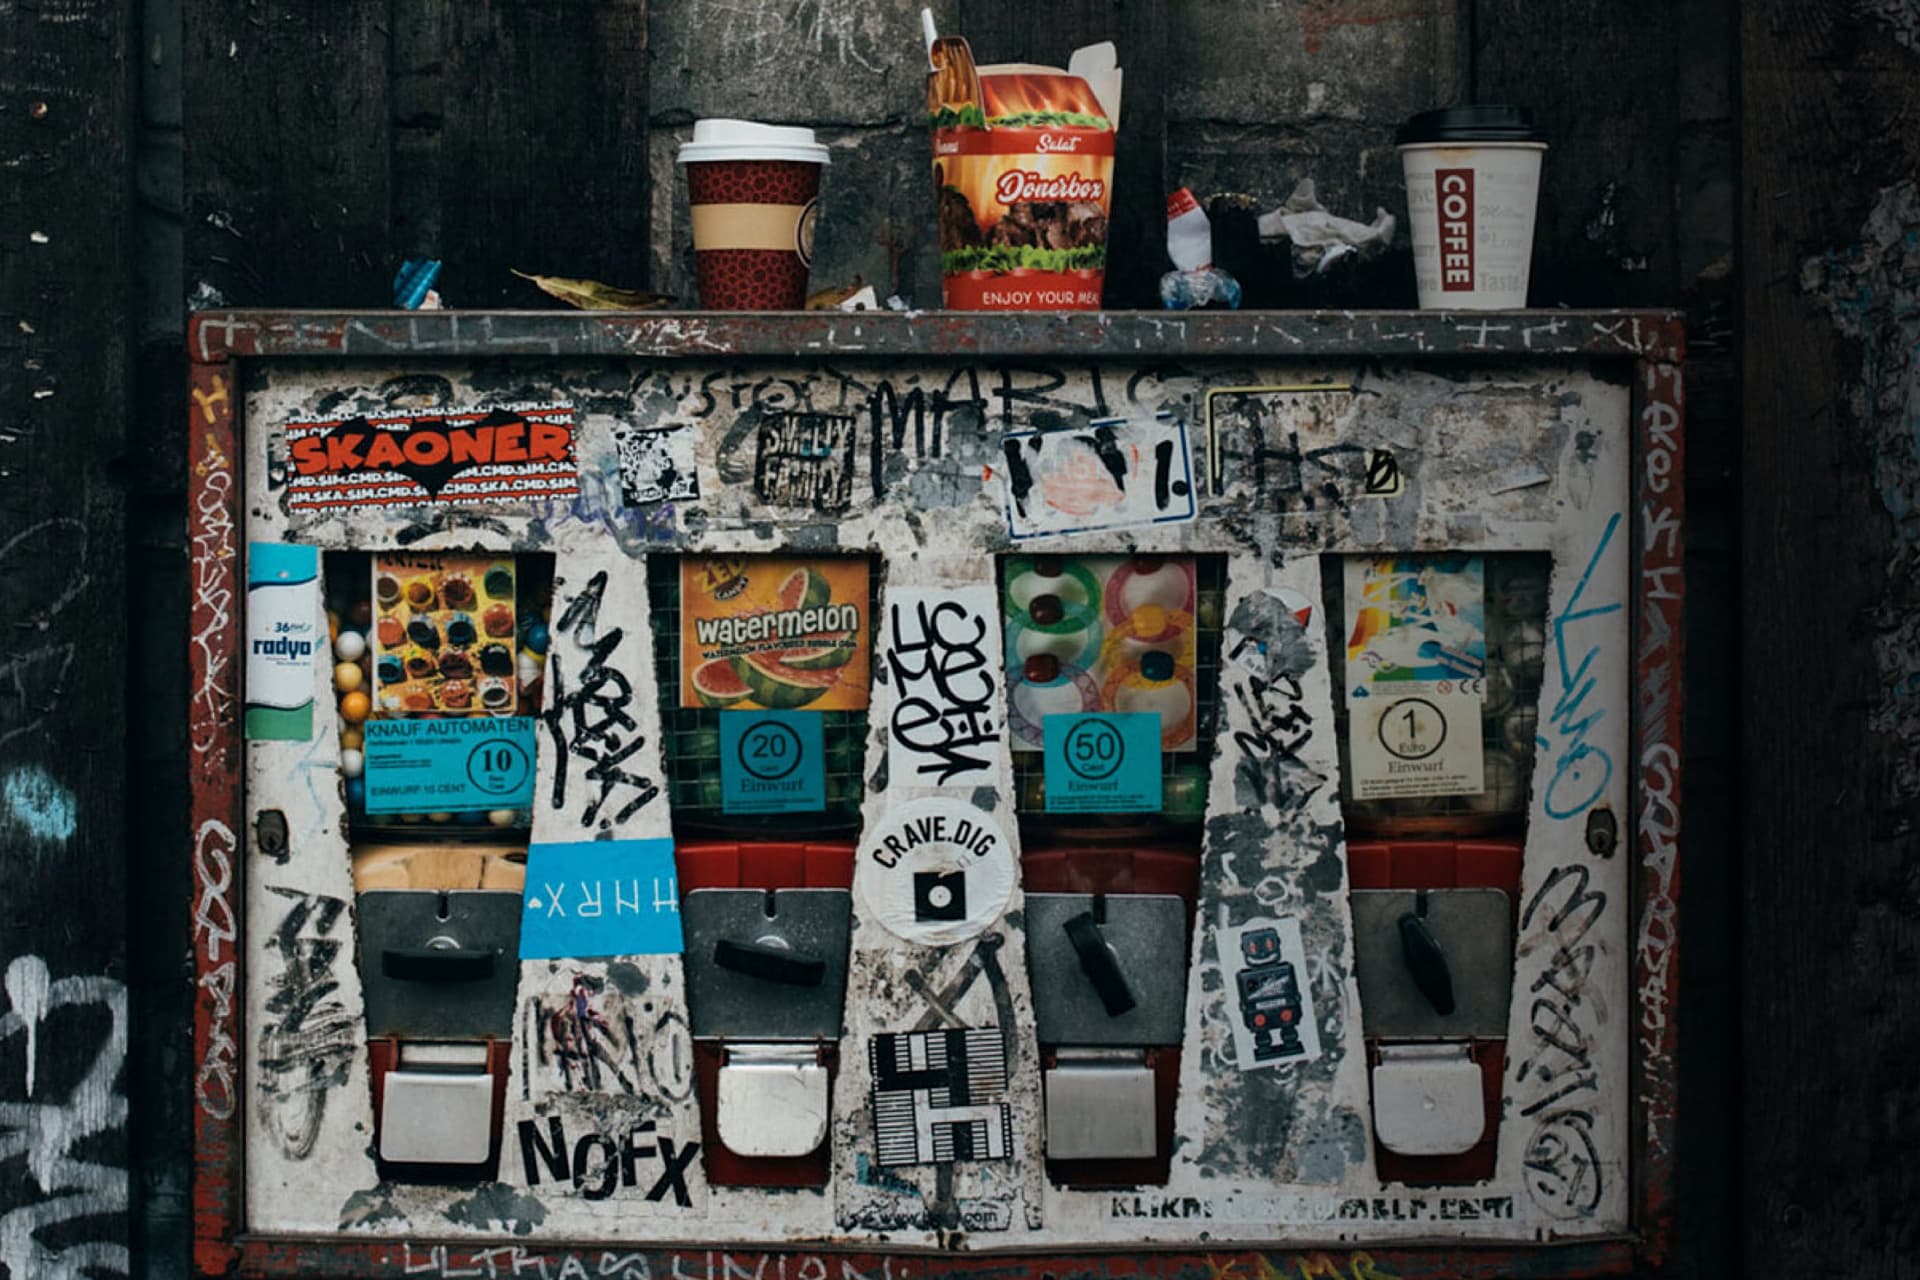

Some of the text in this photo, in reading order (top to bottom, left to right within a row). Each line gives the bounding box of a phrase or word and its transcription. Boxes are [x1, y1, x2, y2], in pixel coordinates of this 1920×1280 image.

[1035, 132, 1082, 154] Salat
[998, 171, 1104, 203] Dönerbox
[1442, 174, 1470, 284] COFFEE
[982, 291, 1031, 305] ENJOY
[1036, 291, 1074, 305] YOUR
[291, 421, 570, 475] SKAONER
[697, 605, 858, 644] watermelon
[367, 719, 530, 737] KNAUF AUTOMATEN
[1402, 708, 1416, 739] 1
[482, 748, 513, 773] 10
[752, 733, 787, 758] 20
[1076, 732, 1115, 761] 50
[1388, 760, 1444, 773] Einwurf
[872, 815, 997, 869] CRAVE.DIG
[517, 1115, 701, 1208] NOFX
